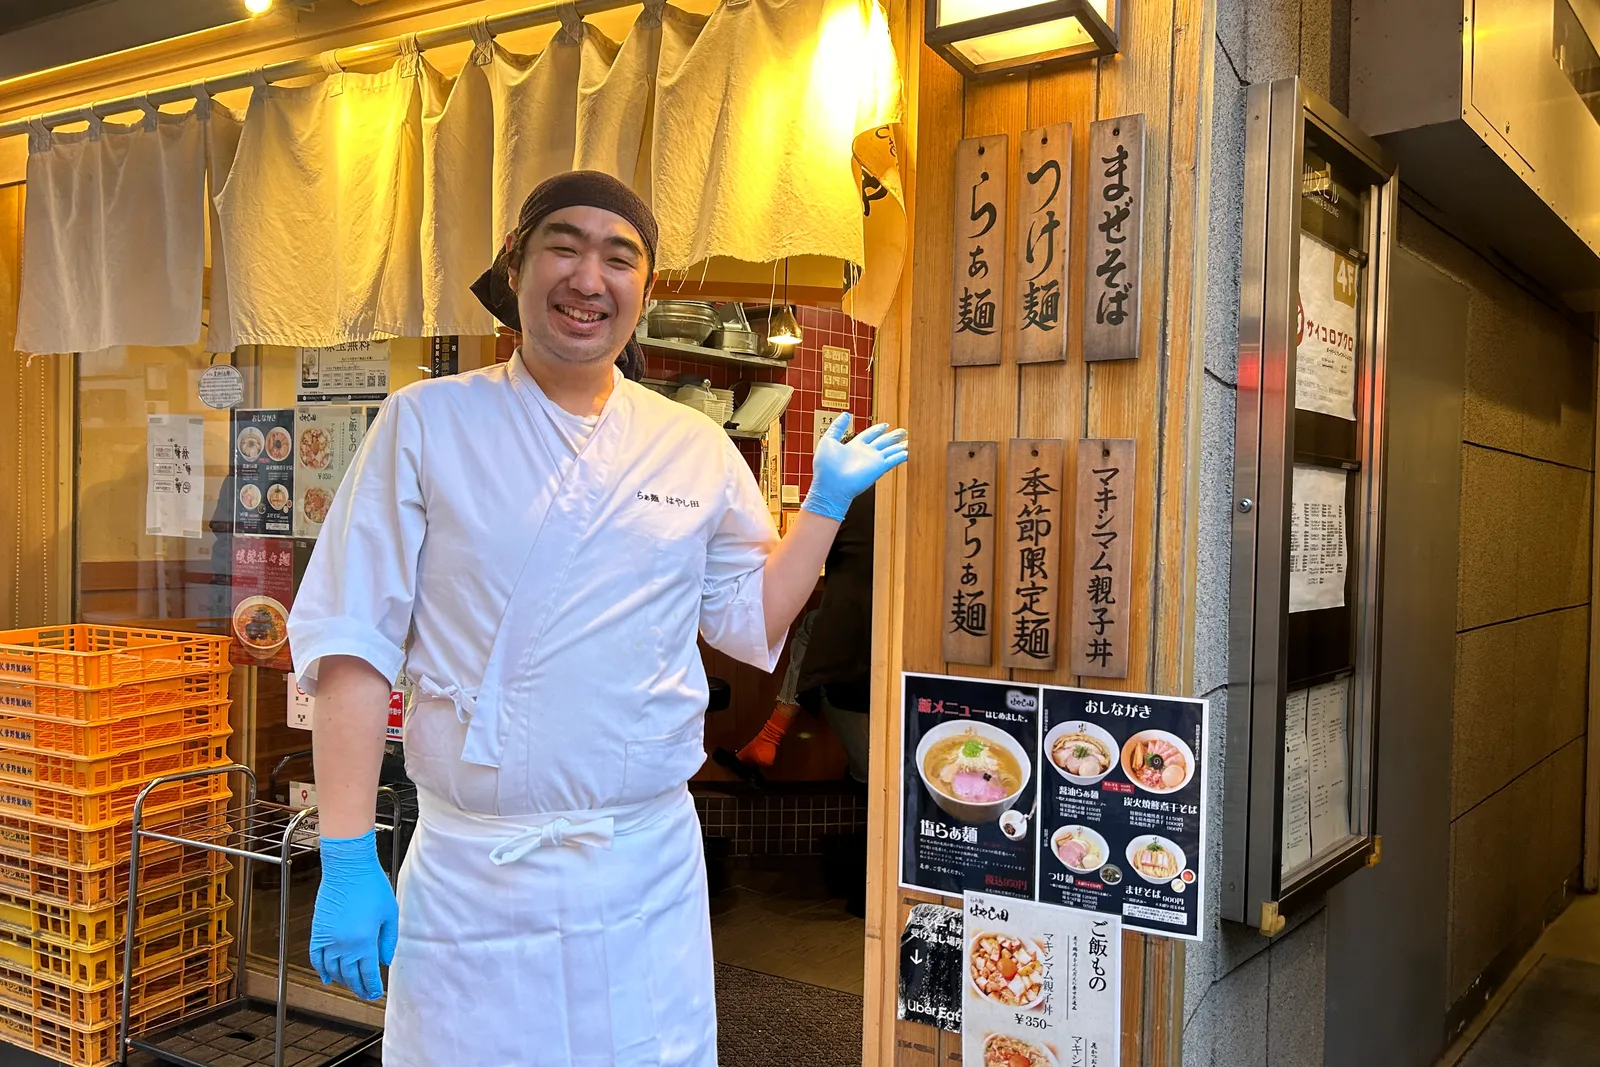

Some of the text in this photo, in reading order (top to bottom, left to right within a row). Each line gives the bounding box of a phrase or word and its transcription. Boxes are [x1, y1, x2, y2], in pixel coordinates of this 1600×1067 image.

[1020, 160, 1061, 332] つけ麺
[1096, 145, 1134, 326] まぜそば
[954, 172, 997, 335] らぁ麺
[1336, 259, 1355, 297] 4F
[252, 414, 276, 422] おしながき
[665, 495, 700, 508] はやし田
[949, 478, 992, 637] 塩らぁ麺
[1011, 467, 1058, 659] 季節限定麺
[1085, 467, 1120, 668] マキシマム親子丼
[1085, 699, 1152, 719] おしながき
[1059, 786, 1099, 799] 醤油らぁ麺
[920, 819, 978, 844] 塩らぁ麺
[1048, 872, 1074, 884] つけ麺
[1125, 885, 1161, 898] まぜそば
[970, 904, 1009, 922] はやし田
[1088, 920, 1109, 992] ご飯もの
[1043, 933, 1054, 1016] マキシマム親子丼
[908, 999, 962, 1022] Uber Eat
[1071, 1036, 1082, 1067] マキシ
